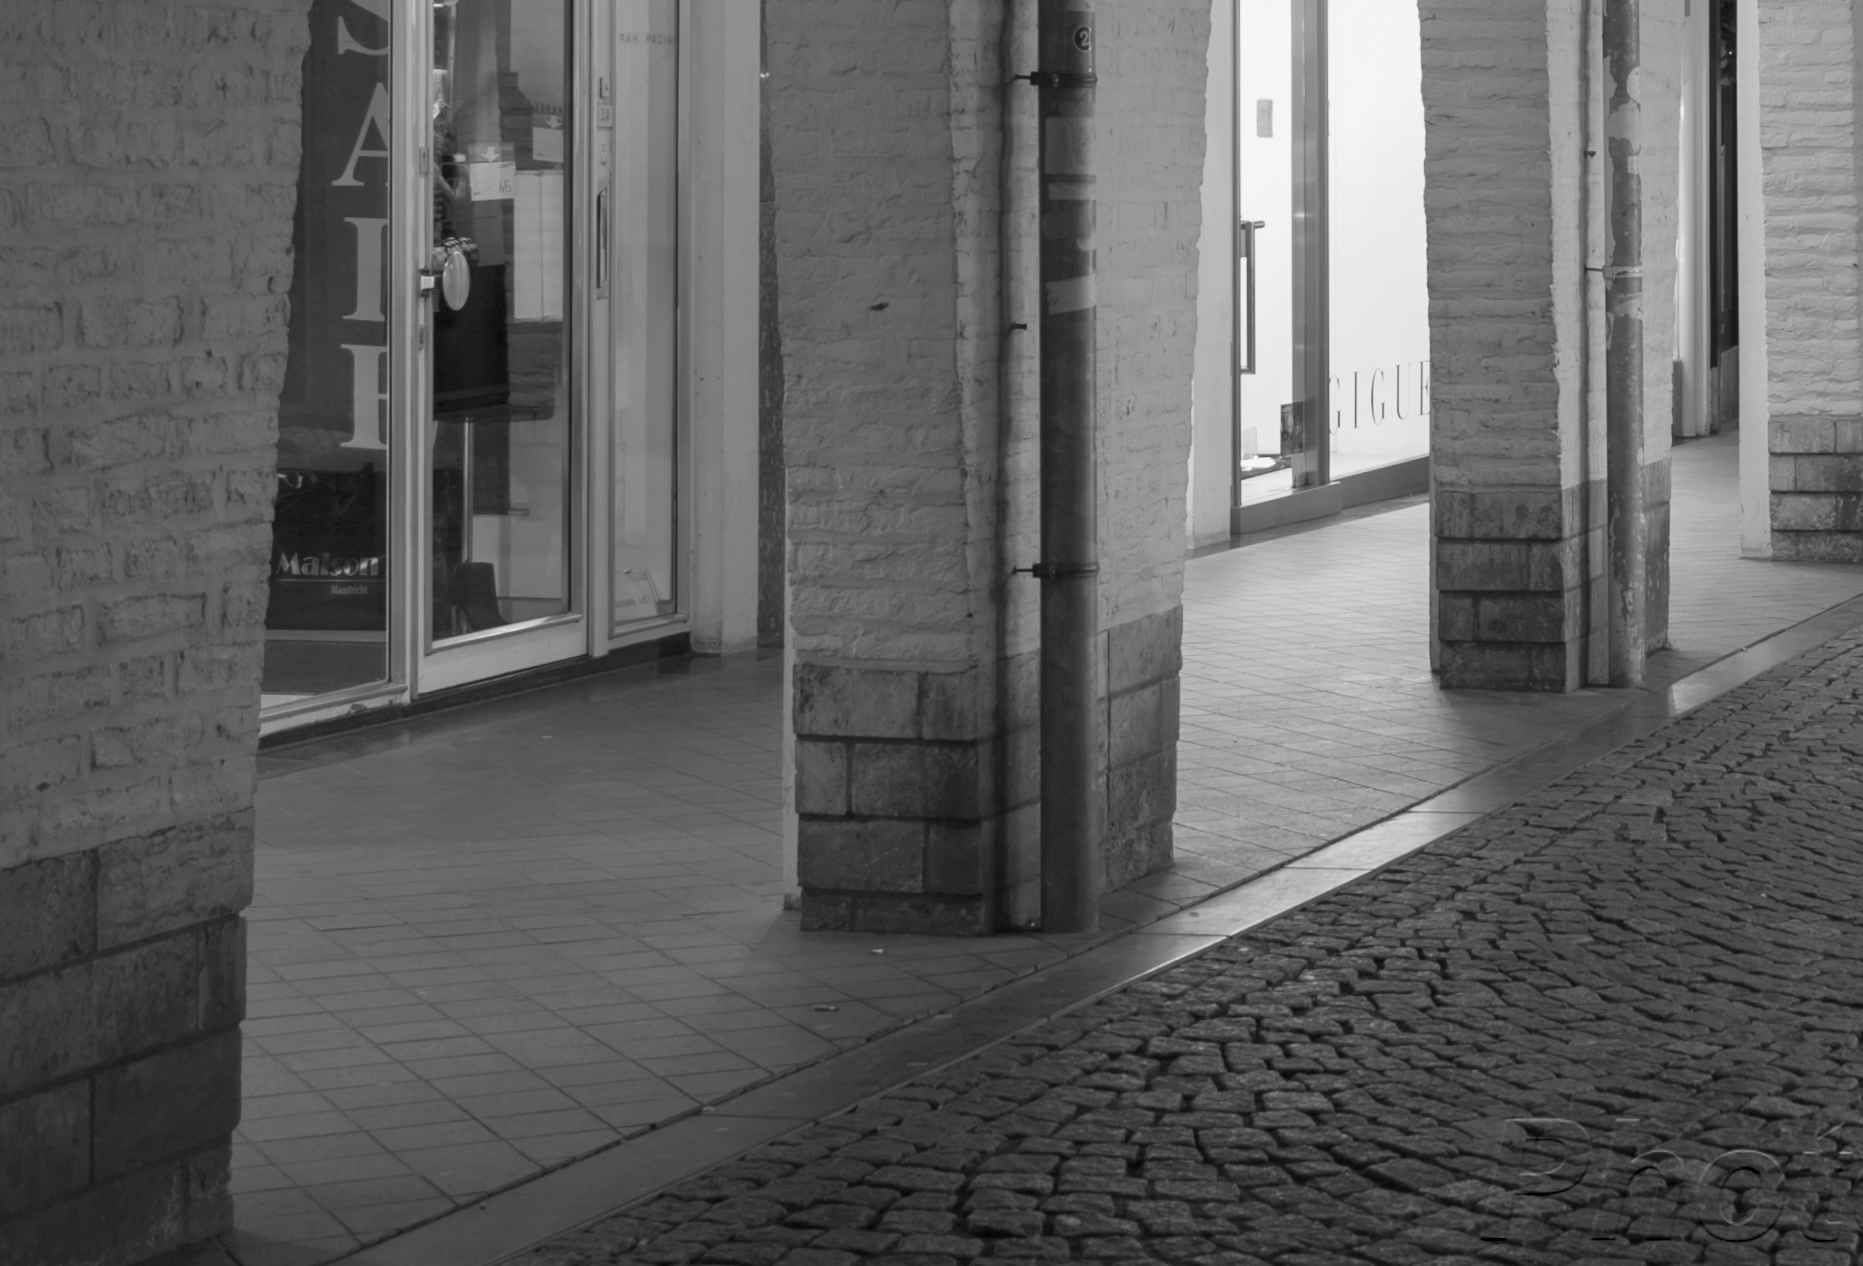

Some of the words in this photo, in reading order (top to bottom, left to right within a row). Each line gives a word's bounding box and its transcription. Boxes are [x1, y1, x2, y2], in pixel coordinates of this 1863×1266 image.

[646, 34, 674, 45] PACIN
[1079, 30, 1091, 47] 2
[1329, 360, 1430, 435] GIGUE
[276, 552, 379, 576] Maison
[330, 584, 368, 595] Maastricht
